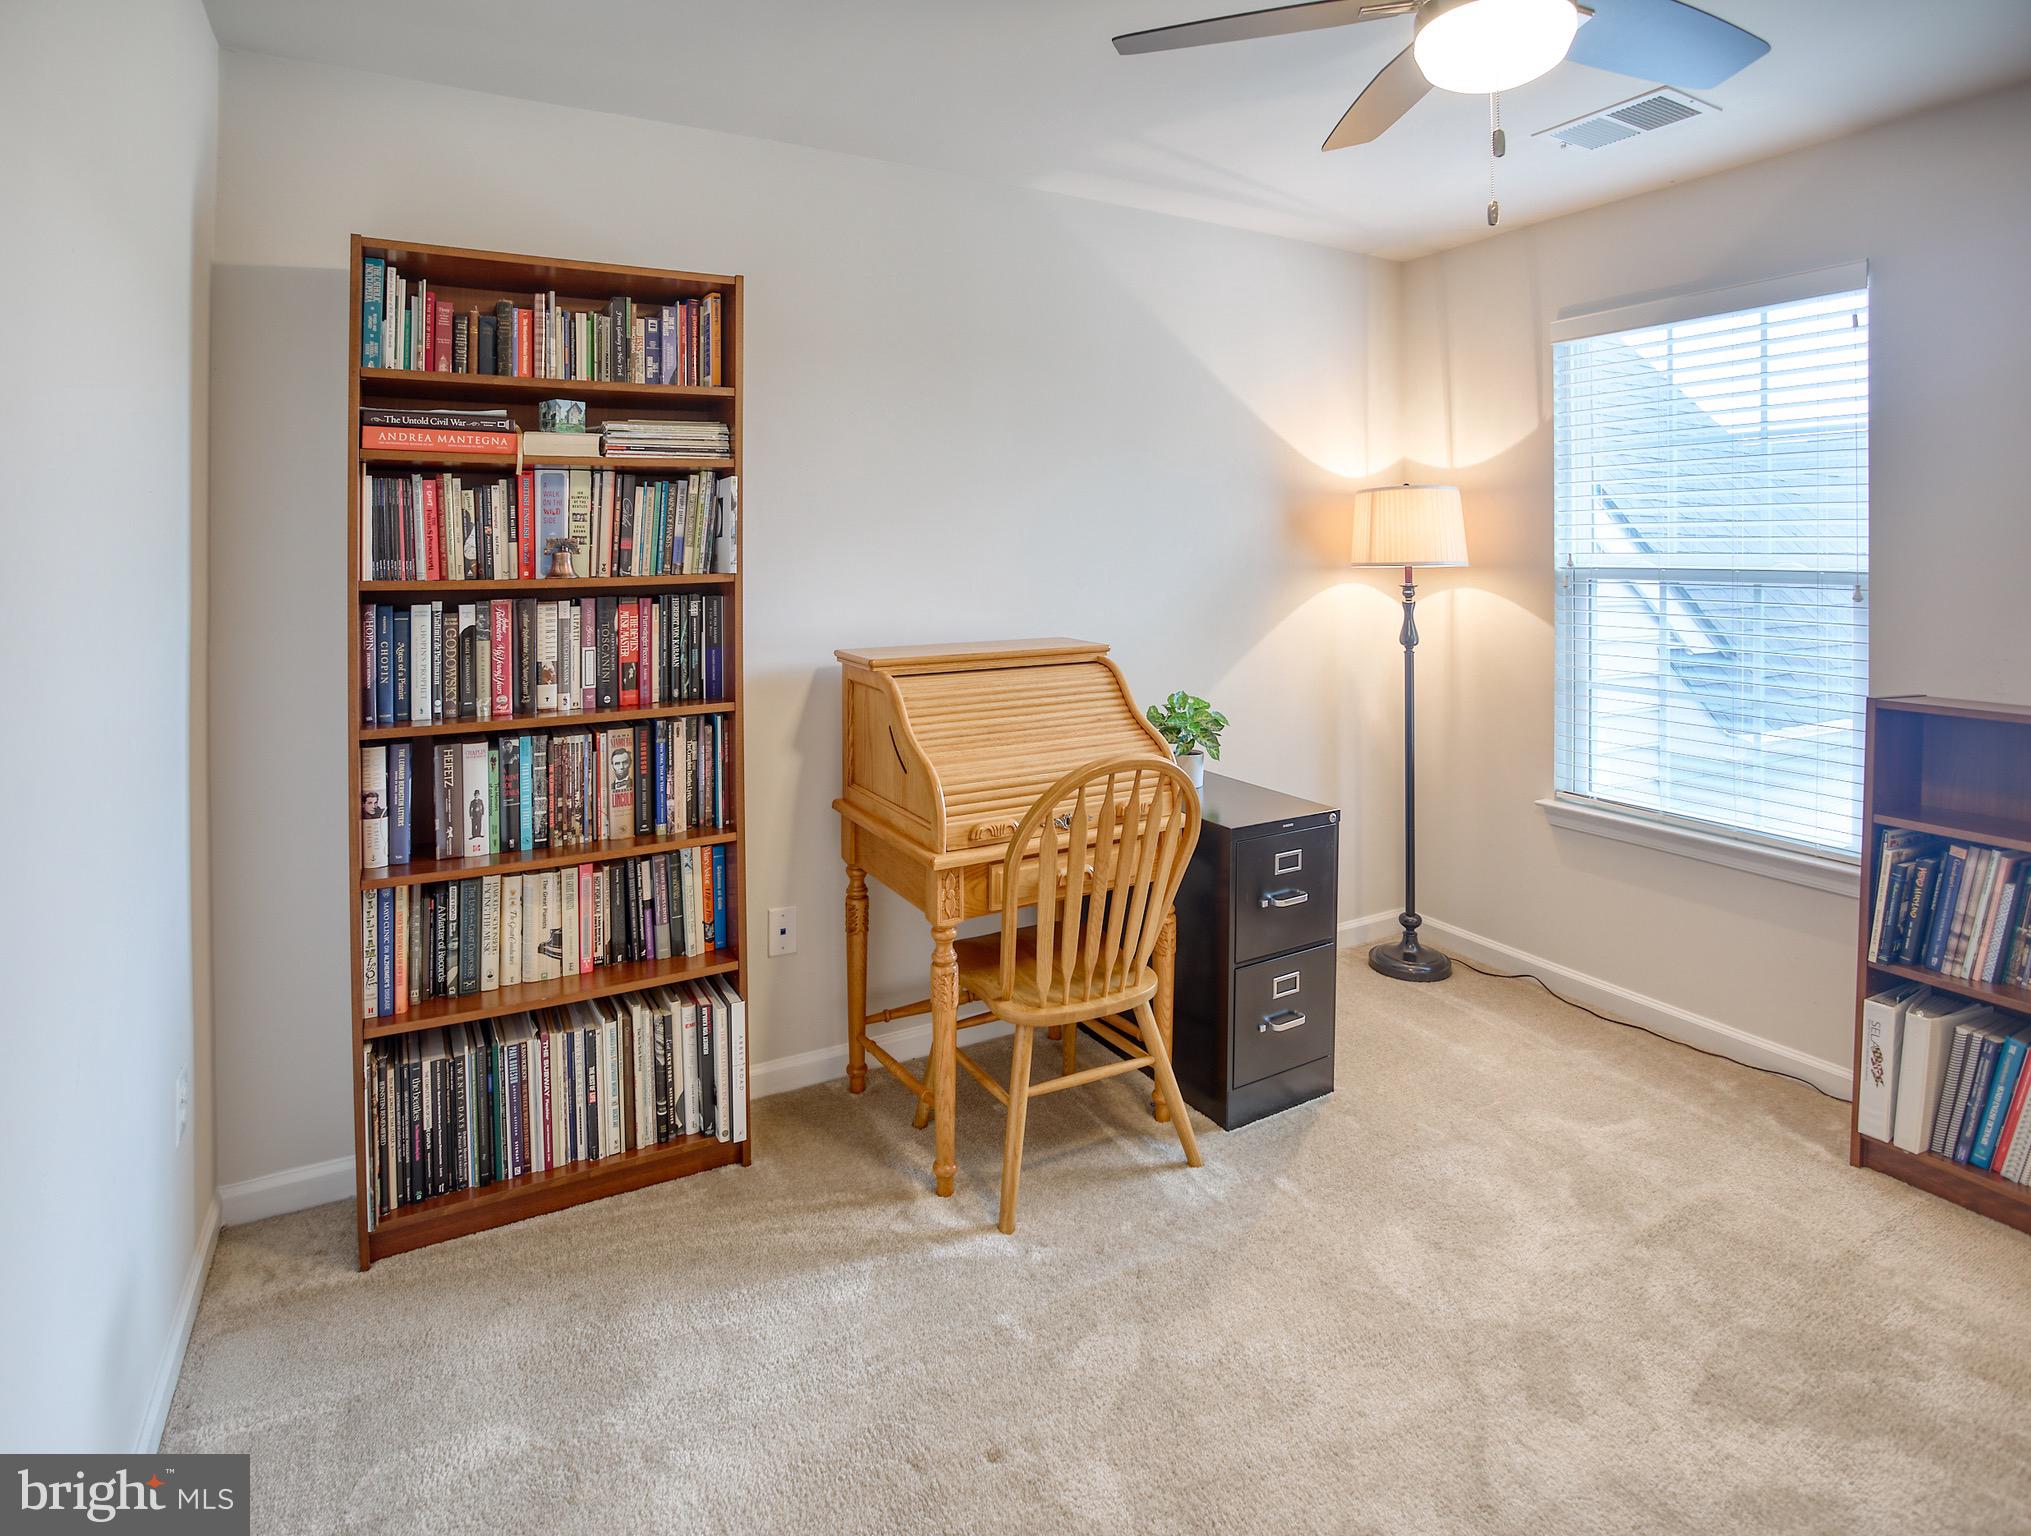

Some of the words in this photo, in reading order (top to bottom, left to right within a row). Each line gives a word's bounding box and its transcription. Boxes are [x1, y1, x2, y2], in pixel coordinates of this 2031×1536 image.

[615, 326, 623, 346] Galway
[384, 415, 400, 424] The
[402, 416, 429, 425] Untold
[430, 417, 448, 426] Civil
[450, 418, 466, 427] War
[378, 432, 432, 442] ANDREA
[437, 434, 508, 446] MANTEGNA
[667, 487, 675, 514] SPEAKING
[667, 514, 673, 522] OF
[365, 611, 374, 650] CHOPIN
[496, 606, 505, 641] Rubinstein
[620, 610, 629, 630] MUSIC
[630, 614, 638, 628] THE
[493, 642, 505, 656] My
[620, 631, 629, 657] MASTER
[630, 628, 638, 652] DEVIL'S
[380, 642, 388, 684] CHOPIN
[396, 642, 404, 662] Notes
[602, 622, 610, 683] TOSCANINI
[445, 628, 456, 704] GODOWSKY
[398, 678, 406, 700] Pianist
[420, 664, 428, 700] PROPHET
[444, 749, 454, 788] HEIFETZ
[612, 792, 633, 808] LINCOLN
[438, 914, 446, 940] Matter
[438, 942, 446, 950] of
[438, 951, 446, 982] Records
[508, 1046, 517, 1058] PAUL
[412, 1078, 420, 1091] the
[412, 1092, 420, 1122] beatles
